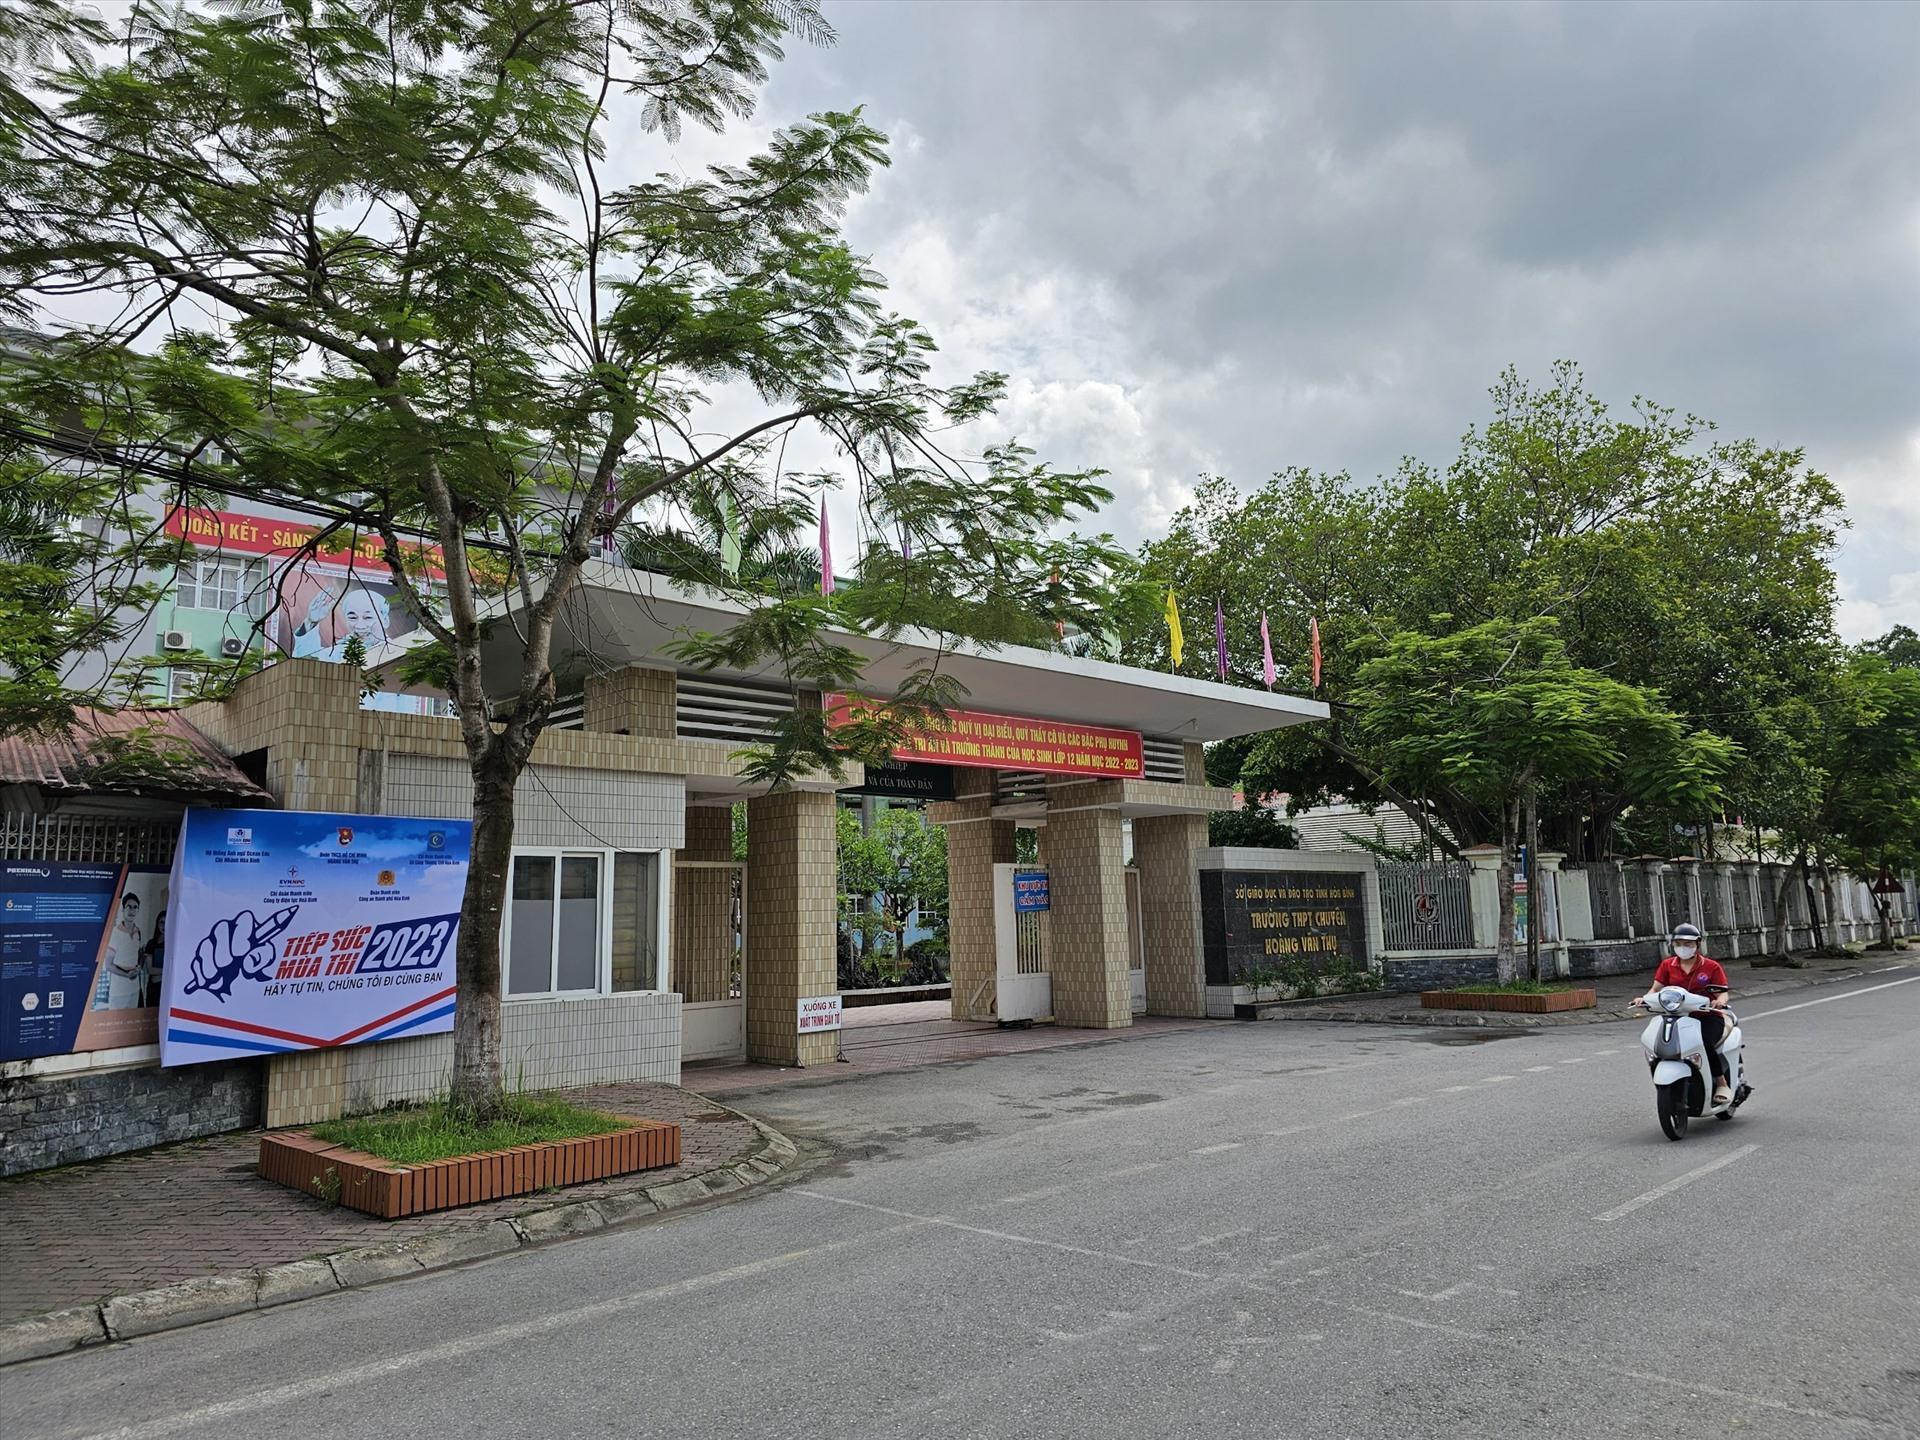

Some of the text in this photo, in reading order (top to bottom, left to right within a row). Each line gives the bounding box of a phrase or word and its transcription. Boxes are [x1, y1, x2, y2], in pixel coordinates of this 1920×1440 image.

[230, 518, 258, 542] KẾT
[958, 720, 972, 735] QUÝ
[974, 722, 982, 739] VỊ
[983, 723, 995, 740] ĐẠI
[996, 720, 1014, 740] BIỂU,
[1016, 726, 1028, 741] QUÝ
[1048, 729, 1056, 744] CÔ
[1058, 730, 1066, 744] VÀ
[1068, 731, 1080, 746] CÁC
[1095, 736, 1107, 751] PHỤ
[914, 738, 926, 751] TRI
[940, 737, 950, 754] VÀ
[952, 737, 980, 756] TRƯỞNG
[982, 742, 1005, 759] THÀNH
[1007, 742, 1020, 760] CỦA
[1022, 748, 1035, 764] HỌC
[1037, 750, 1052, 763] SINH
[1054, 748, 1065, 764] LỚP
[1067, 753, 1075, 765] 12
[1092, 754, 1104, 769] HỌC
[1105, 756, 1120, 769] 2022
[1124, 758, 1139, 770] 2023
[868, 774, 933, 790] VÀ CỦA TOÀN DÂN
[6, 900, 13, 908] 6
[1236, 884, 1245, 899] SỞ
[1247, 885, 1262, 899] GIÁO
[1265, 888, 1277, 902] DỤC
[1278, 885, 1287, 898] VÀ
[1289, 885, 1300, 898] ĐÀO
[1303, 889, 1314, 901] TẠO
[1316, 885, 1328, 898] TỈNH
[1251, 907, 1346, 928] TRƯỜNG THPT CHUYÊN
[283, 921, 449, 969] TIẾP SỨC 2023
[1265, 932, 1337, 956] HOÀNG VĂN THỤ
[275, 953, 360, 980] MÙA THI
[264, 972, 443, 996] HÃY TỰ TIN, CHÚNG TÔI ĐI CÙNG BẠN
[803, 999, 836, 1012] XUỐNG XE
[800, 1013, 810, 1028] XUẤT
[811, 1013, 823, 1027] TRÌNH
[835, 1011, 840, 1024] TỜ
